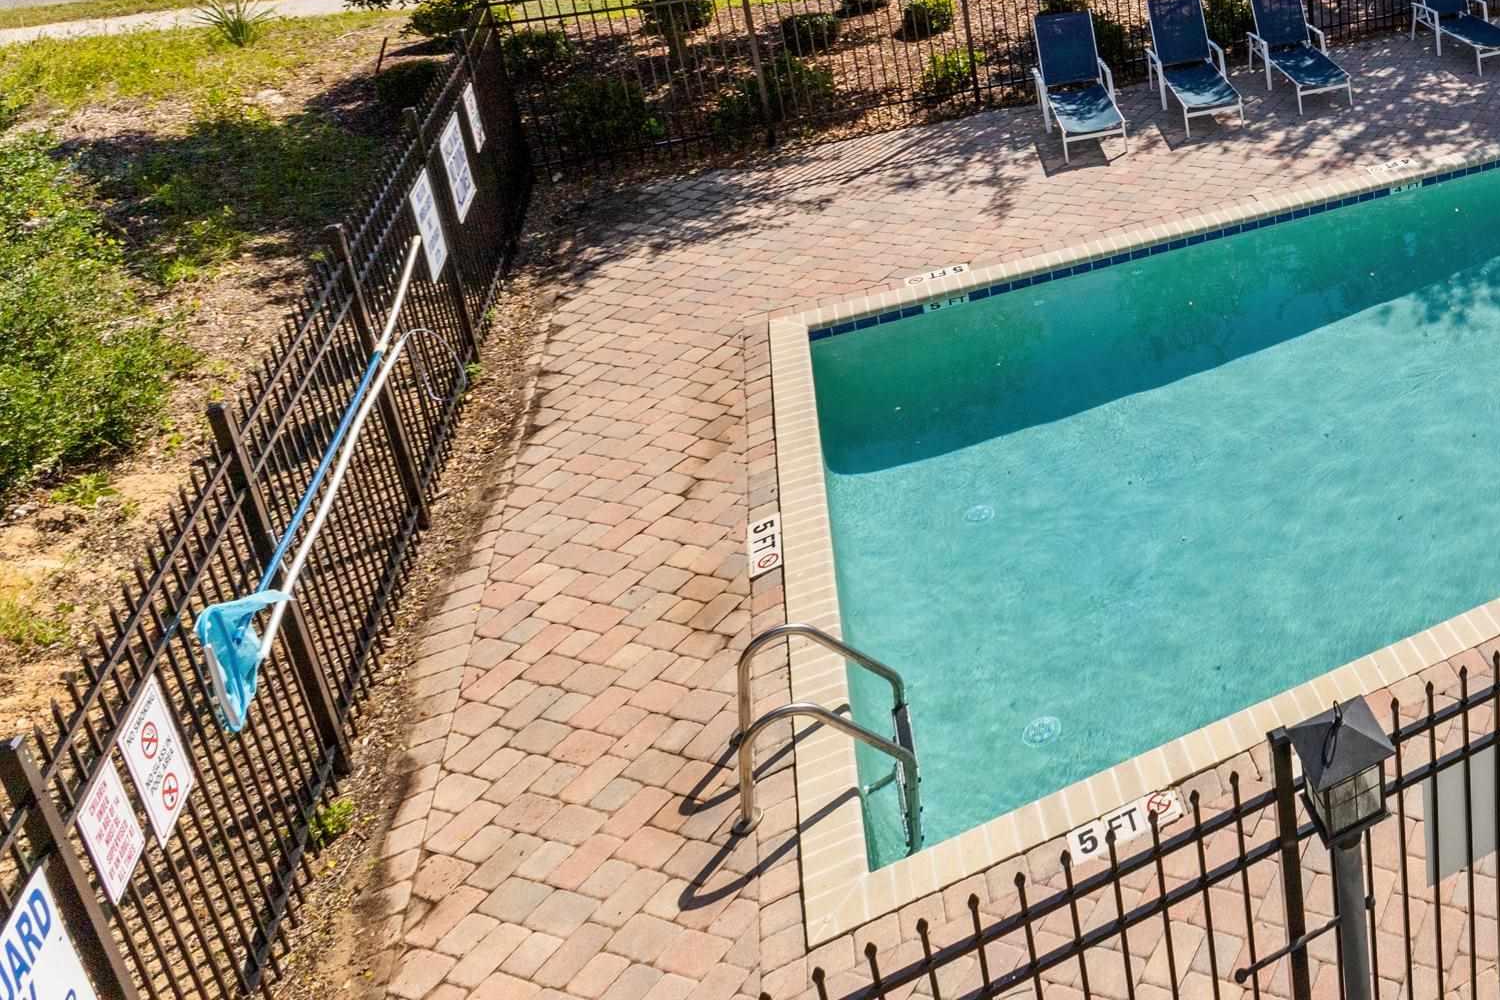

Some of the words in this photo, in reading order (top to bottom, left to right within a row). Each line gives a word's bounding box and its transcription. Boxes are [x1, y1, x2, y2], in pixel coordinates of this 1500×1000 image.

[928, 270, 946, 279] FT
[953, 266, 964, 274] 5
[930, 302, 940, 310] 5
[949, 296, 963, 306] FT
[753, 520, 774, 534] 5
[753, 534, 776, 553] FT
[134, 696, 155, 733] SMOKING
[1078, 828, 1098, 854] 5
[1108, 807, 1137, 832] FT
